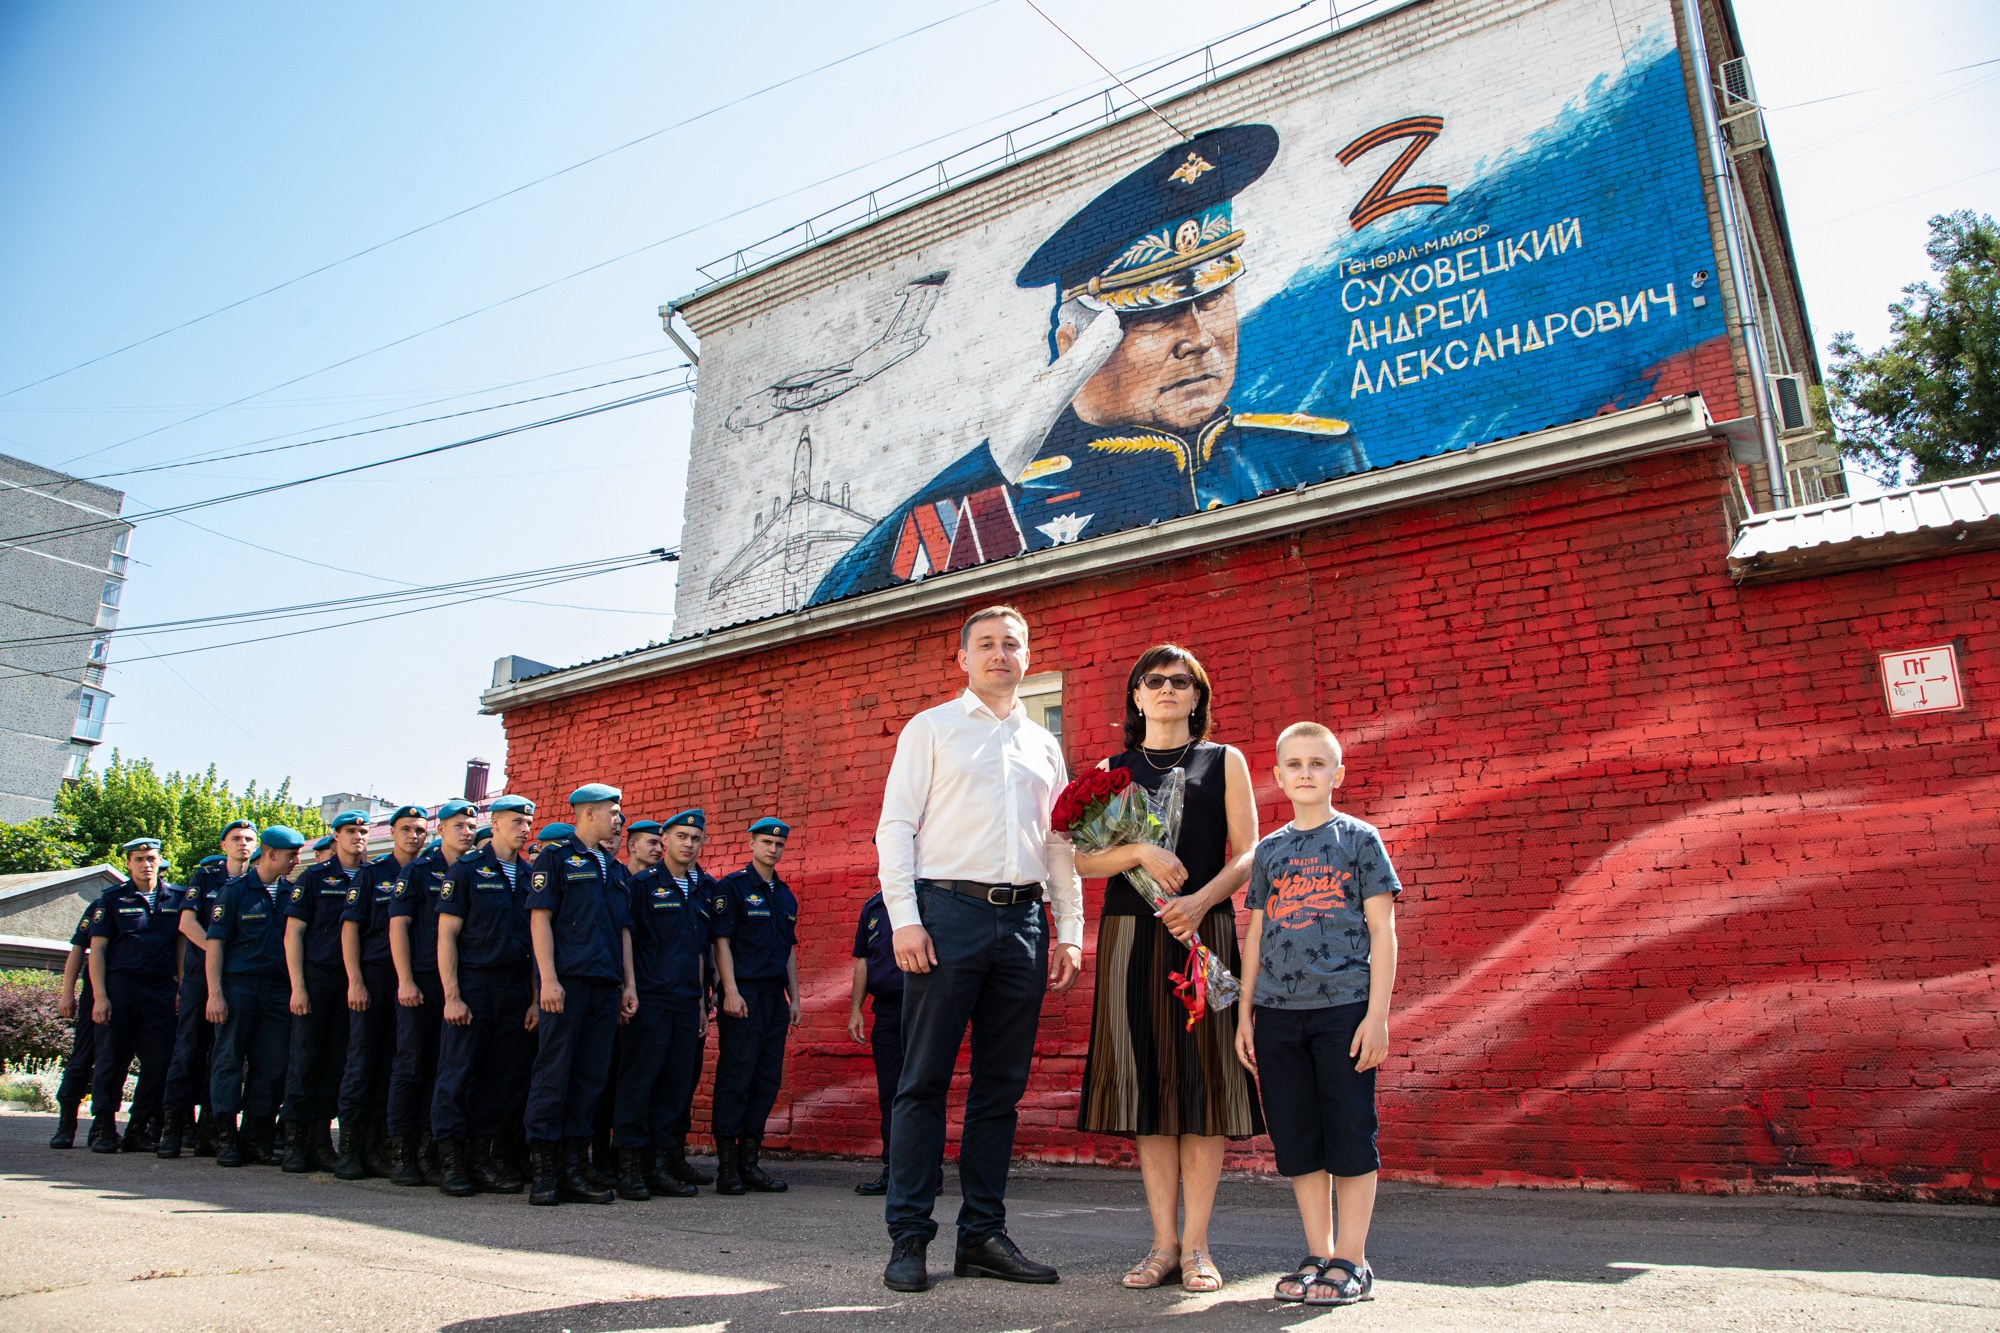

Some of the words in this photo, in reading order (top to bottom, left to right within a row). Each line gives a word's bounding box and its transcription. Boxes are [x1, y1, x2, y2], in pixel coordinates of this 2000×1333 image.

[1335, 115, 1449, 231] Z
[1341, 217, 1583, 313] СУХОВЕЦКИЙ
[1347, 288, 1488, 356] АНДРЕЙ
[1350, 283, 1678, 399] АЛЕКСАНДРОВИЧ
[1903, 657, 1930, 676] ПГ
[1289, 857, 1319, 866] AMAZING
[1302, 865, 1334, 875] SURFING
